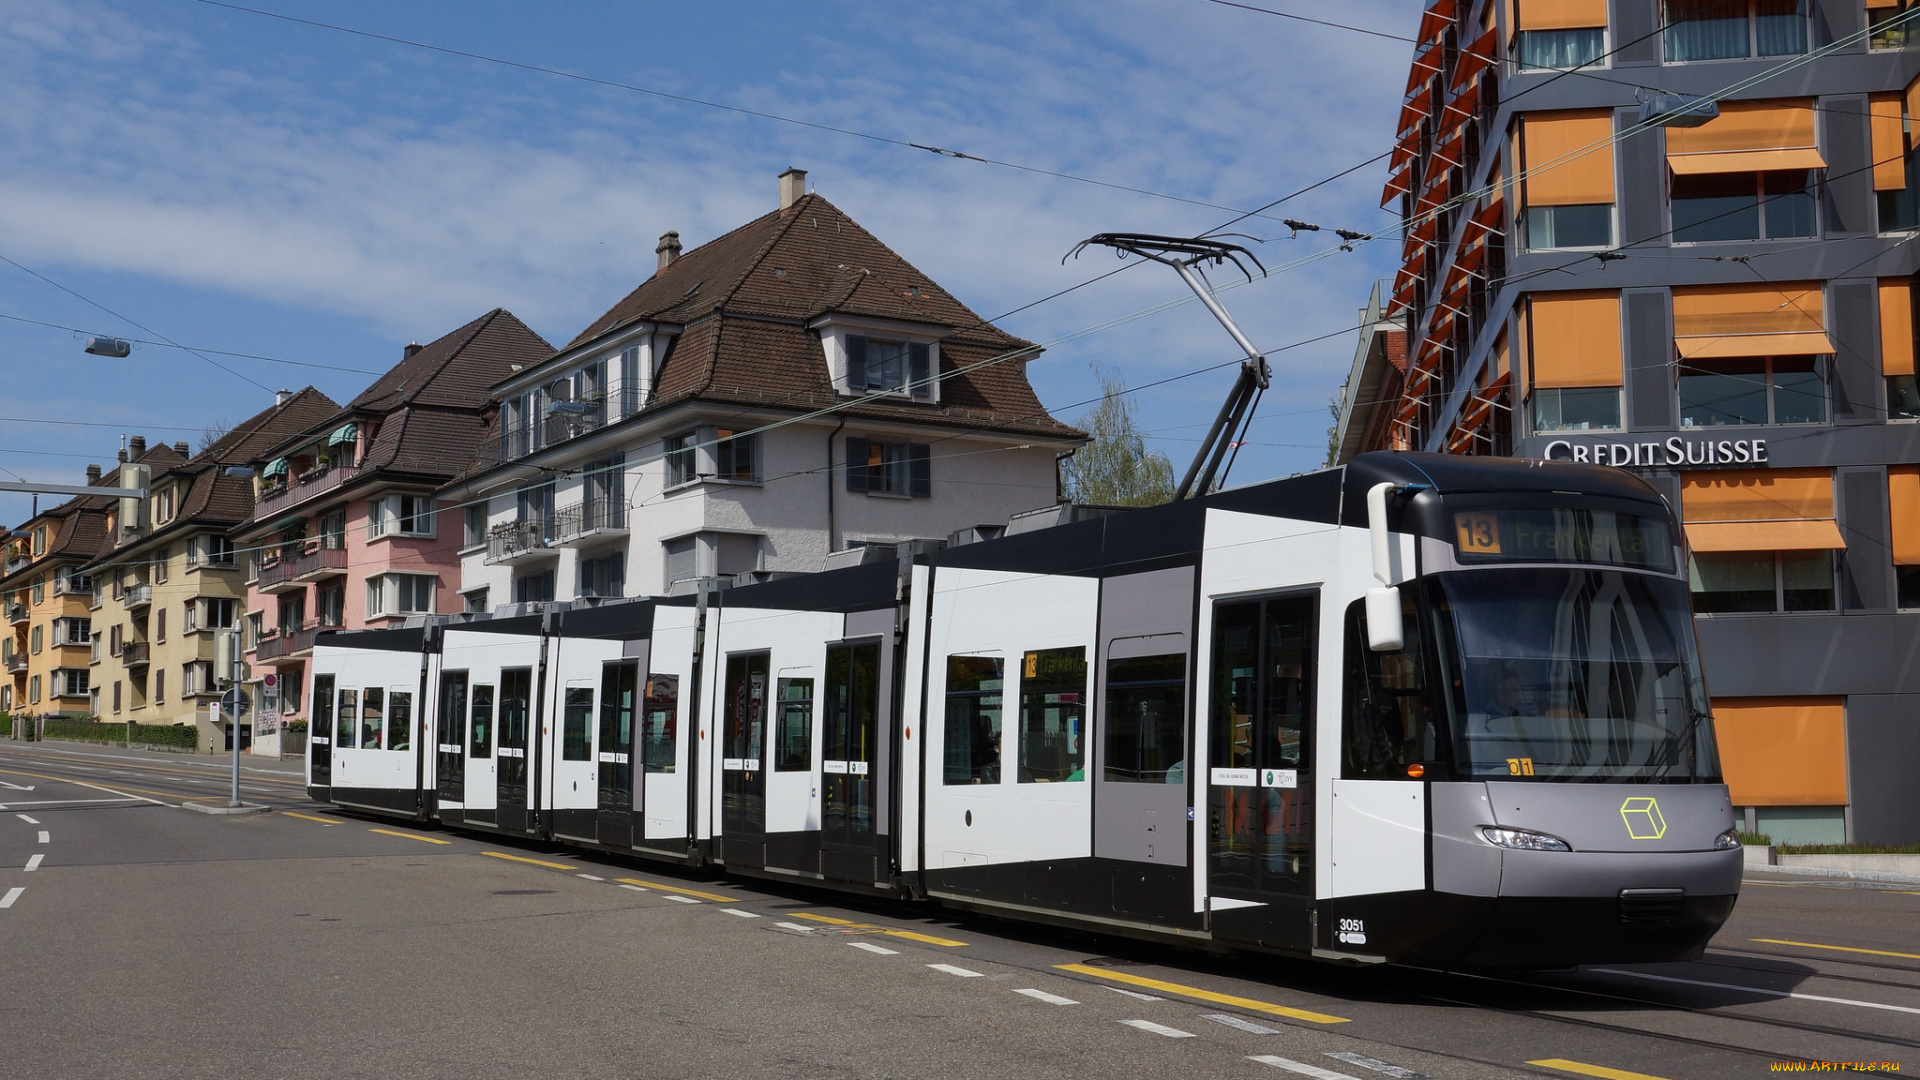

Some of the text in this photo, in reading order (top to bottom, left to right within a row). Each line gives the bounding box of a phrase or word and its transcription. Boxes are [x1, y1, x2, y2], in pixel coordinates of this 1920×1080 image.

[1544, 436, 1768, 467] CREDIT SUISSE
[1460, 518, 1494, 548] 13
[1339, 918, 1364, 931] 3051
